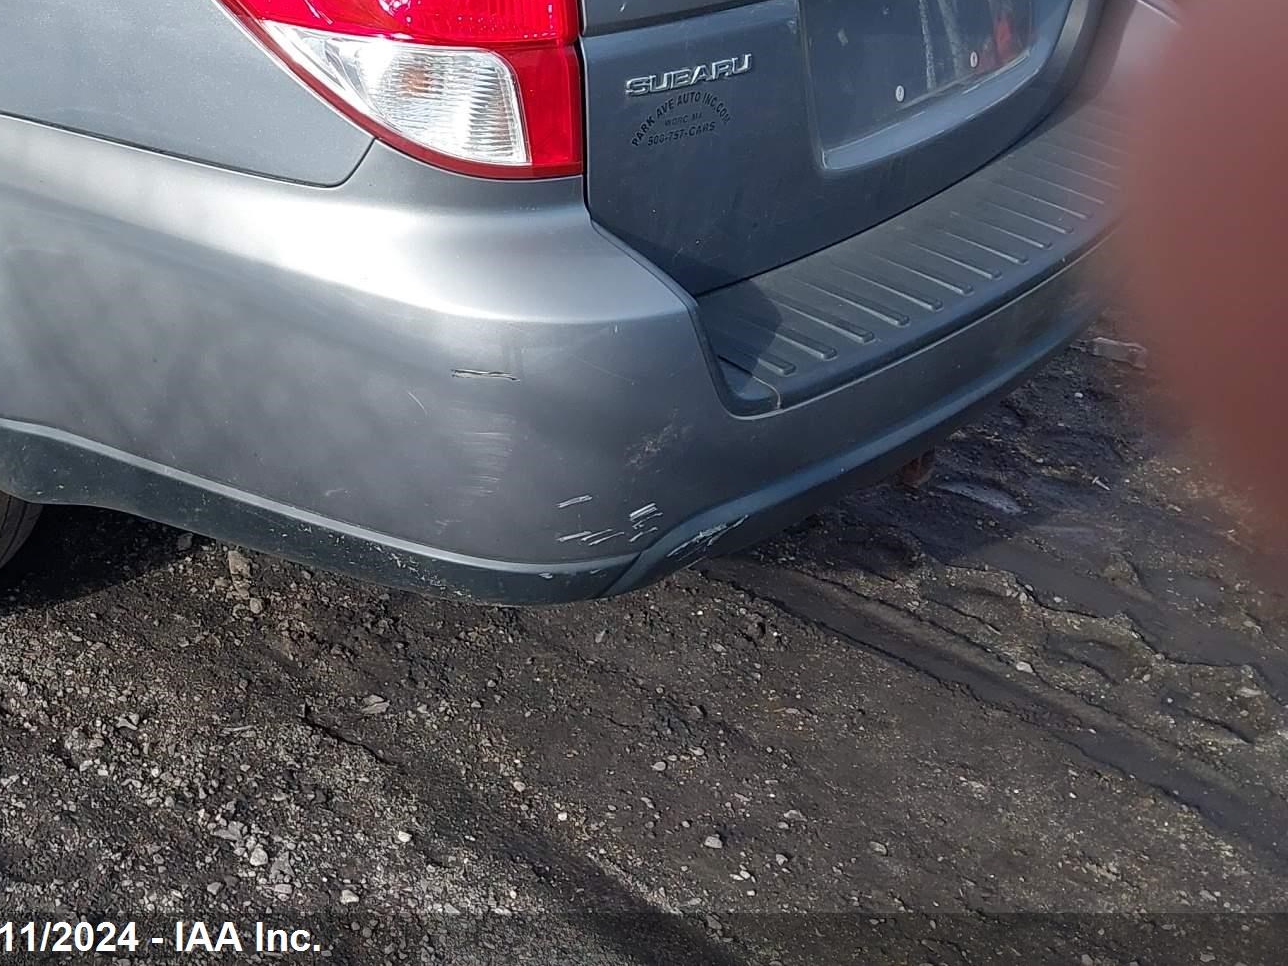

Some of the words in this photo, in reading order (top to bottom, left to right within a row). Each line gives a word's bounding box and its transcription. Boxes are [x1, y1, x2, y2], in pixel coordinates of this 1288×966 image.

[625, 53, 752, 96] SUBARU
[631, 115, 656, 147] PARK
[656, 98, 675, 120] AVE
[676, 91, 701, 107] AUTO
[647, 121, 716, 147] 508-757-CARS
